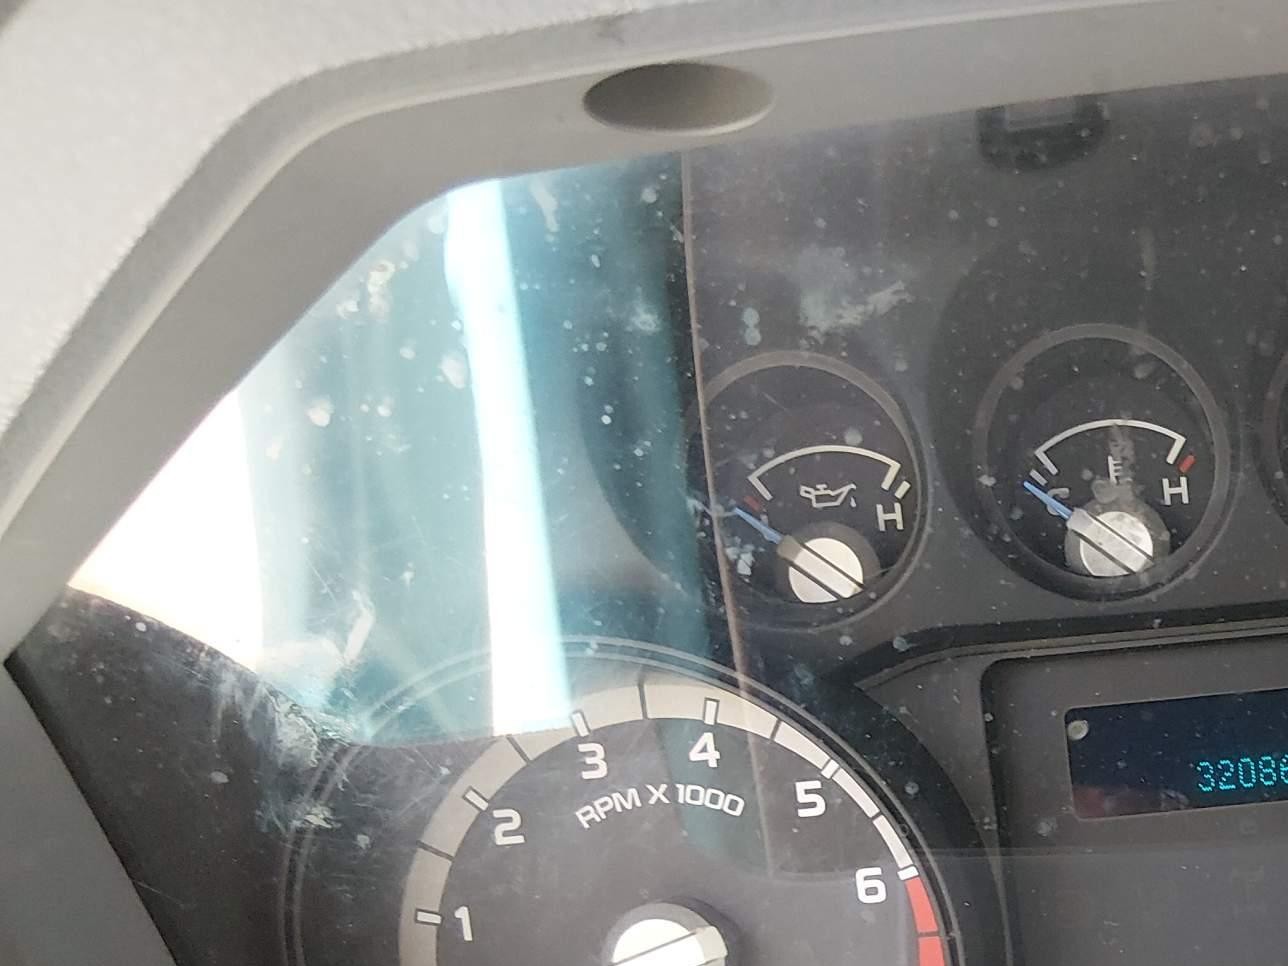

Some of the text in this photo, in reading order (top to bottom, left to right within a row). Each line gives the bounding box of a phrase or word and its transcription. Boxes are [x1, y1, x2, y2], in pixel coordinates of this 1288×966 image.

[1162, 476, 1189, 506] H
[876, 502, 903, 531] H
[579, 743, 608, 779] 3
[688, 733, 720, 768] 4
[575, 783, 745, 829] RPM X 1000
[794, 781, 826, 818] 5
[494, 810, 525, 846] 2
[855, 868, 887, 904] 6
[454, 906, 473, 941] 1
